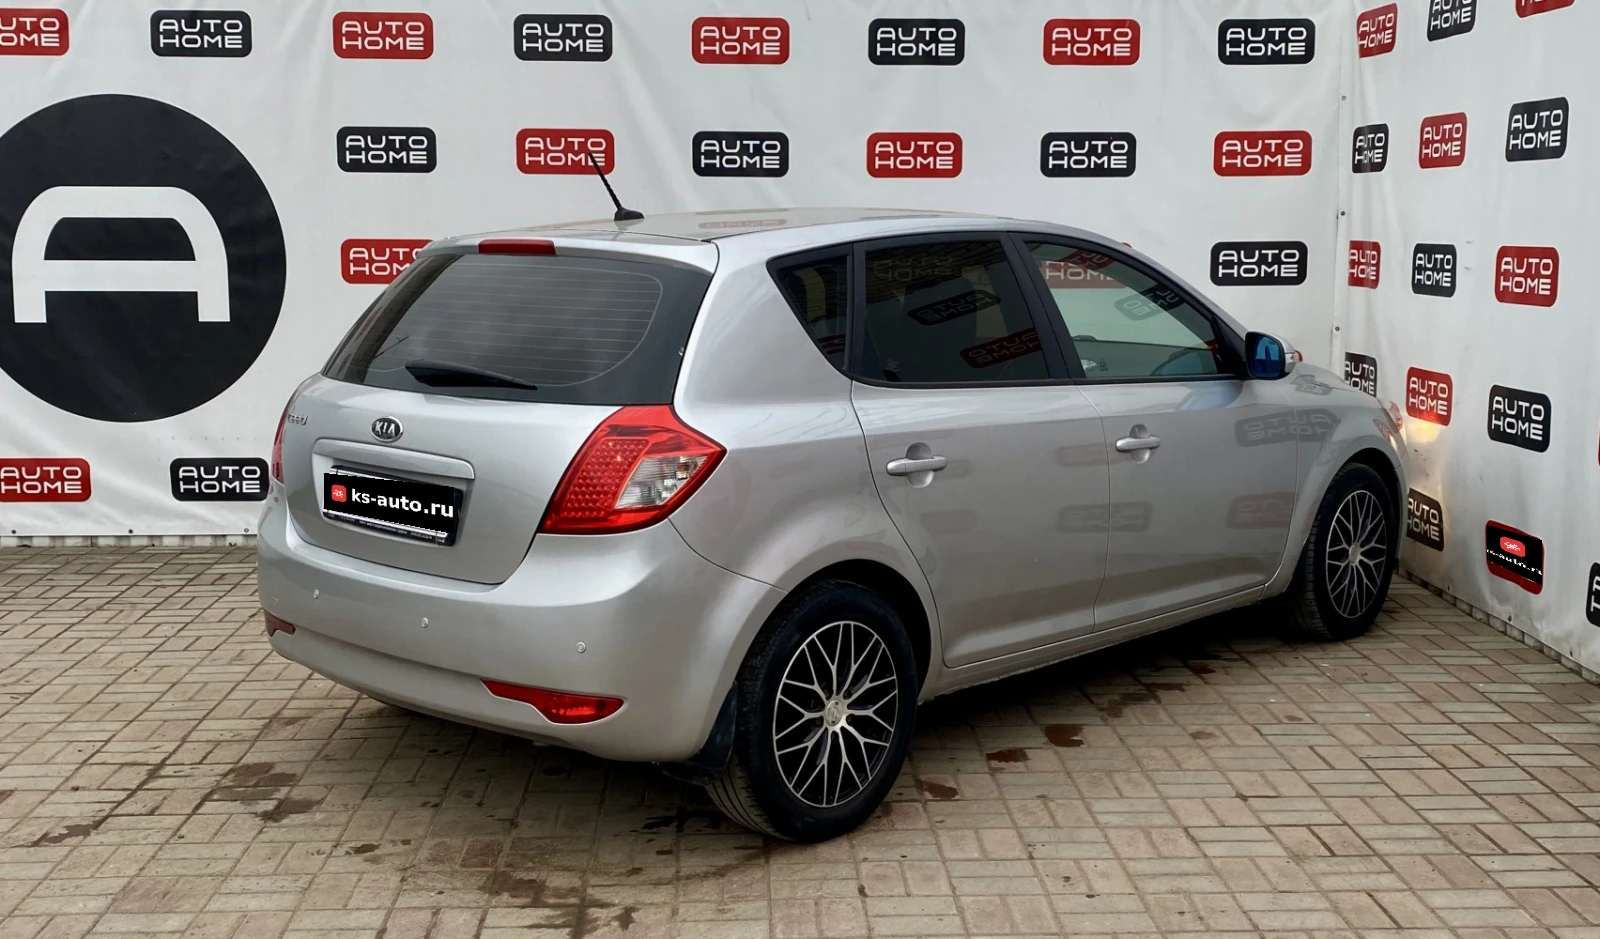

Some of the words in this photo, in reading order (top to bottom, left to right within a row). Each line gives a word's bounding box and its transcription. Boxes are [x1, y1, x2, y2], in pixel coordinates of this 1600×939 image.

[0, 18, 60, 31] UTO
[1359, 12, 1395, 33] AUTO
[1429, 6, 1472, 31] HOME
[159, 19, 243, 33] AUTO
[341, 21, 425, 35] AUTO
[522, 23, 605, 37] AUTO
[700, 26, 782, 40] AUTO
[0, 33, 60, 47] OME
[876, 27, 957, 41] AUTO
[1052, 27, 1132, 41] AUTO
[1226, 27, 1307, 41] AUTO
[1359, 28, 1393, 49] HOME
[159, 34, 243, 49] HOME
[342, 36, 425, 51] HOME
[522, 38, 604, 53] HOME
[700, 41, 782, 56] HOME
[876, 42, 957, 57] HOME
[1051, 43, 1132, 57] HOME
[1225, 42, 1307, 56] HOME
[1510, 109, 1564, 131] AUTO
[1423, 122, 1463, 141] AUTO
[345, 135, 428, 149] AUTO
[524, 136, 607, 151] AUTO
[700, 139, 781, 154] AUTO
[1048, 140, 1129, 154] AUTO
[1222, 139, 1304, 153] AUTO
[1355, 132, 1386, 149] AUTO
[1508, 129, 1562, 151] HOME
[875, 141, 955, 154] AUTO
[1421, 140, 1462, 158] HOME
[345, 150, 428, 164] HOME
[525, 152, 606, 166] HOME
[700, 154, 781, 169] HOME
[875, 156, 954, 169] HOME
[1048, 155, 1129, 169] HOME
[1222, 153, 1303, 168] HOME
[1354, 148, 1384, 164] HOME
[1218, 249, 1300, 263] AUTO
[1415, 253, 1453, 270] AUTO
[350, 262, 411, 276] HOM
[1218, 264, 1299, 278] HOME
[1500, 256, 1553, 275] AUTO
[1045, 267, 1115, 281] HOM
[1414, 269, 1452, 287] HOME
[1499, 275, 1552, 295] HOME
[1409, 376, 1449, 399] AUTO
[1408, 393, 1448, 416] HOME
[1492, 395, 1545, 421] AUTO
[374, 421, 397, 437] KIA
[1491, 413, 1543, 441] HOME
[0, 466, 82, 479] AUTO
[178, 466, 261, 479] AUTO
[0, 481, 82, 494] HOME
[179, 480, 261, 493] HOME
